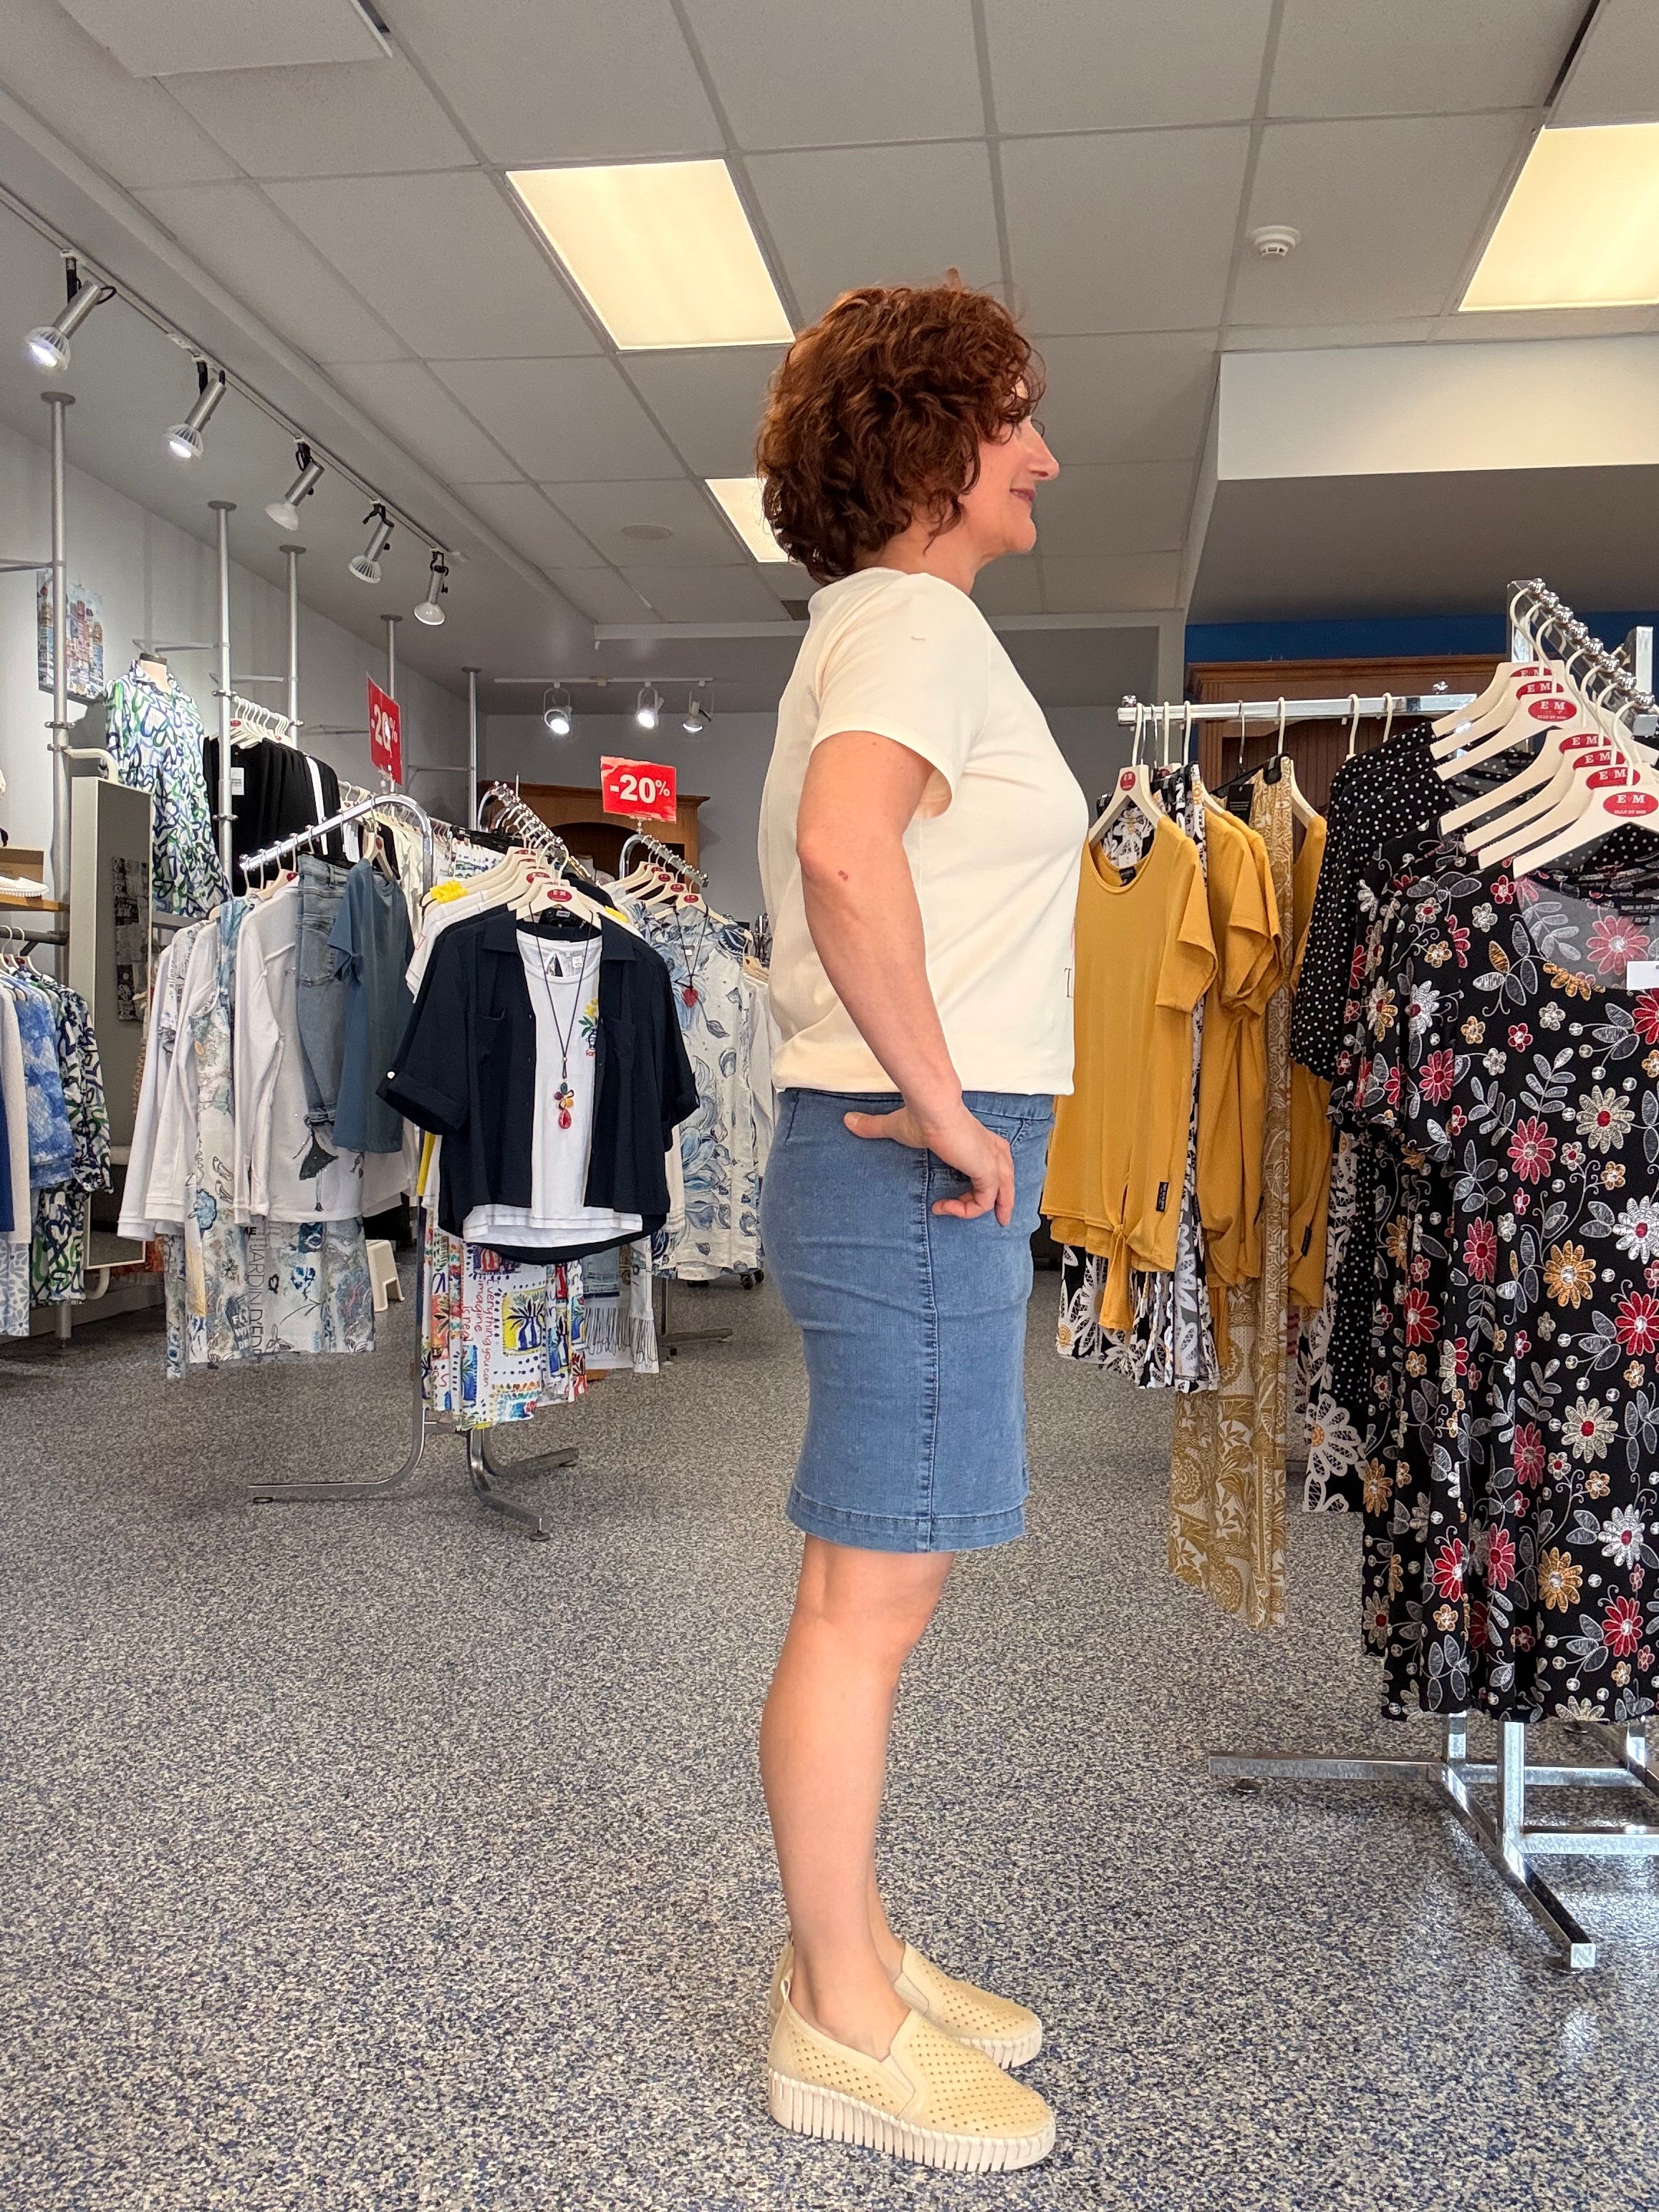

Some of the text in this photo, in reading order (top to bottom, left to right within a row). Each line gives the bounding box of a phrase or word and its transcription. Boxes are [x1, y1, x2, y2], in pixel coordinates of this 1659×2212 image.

[370, 704, 398, 751] -20%
[610, 774, 670, 804] -20%
[471, 1280, 484, 1332] imagine
